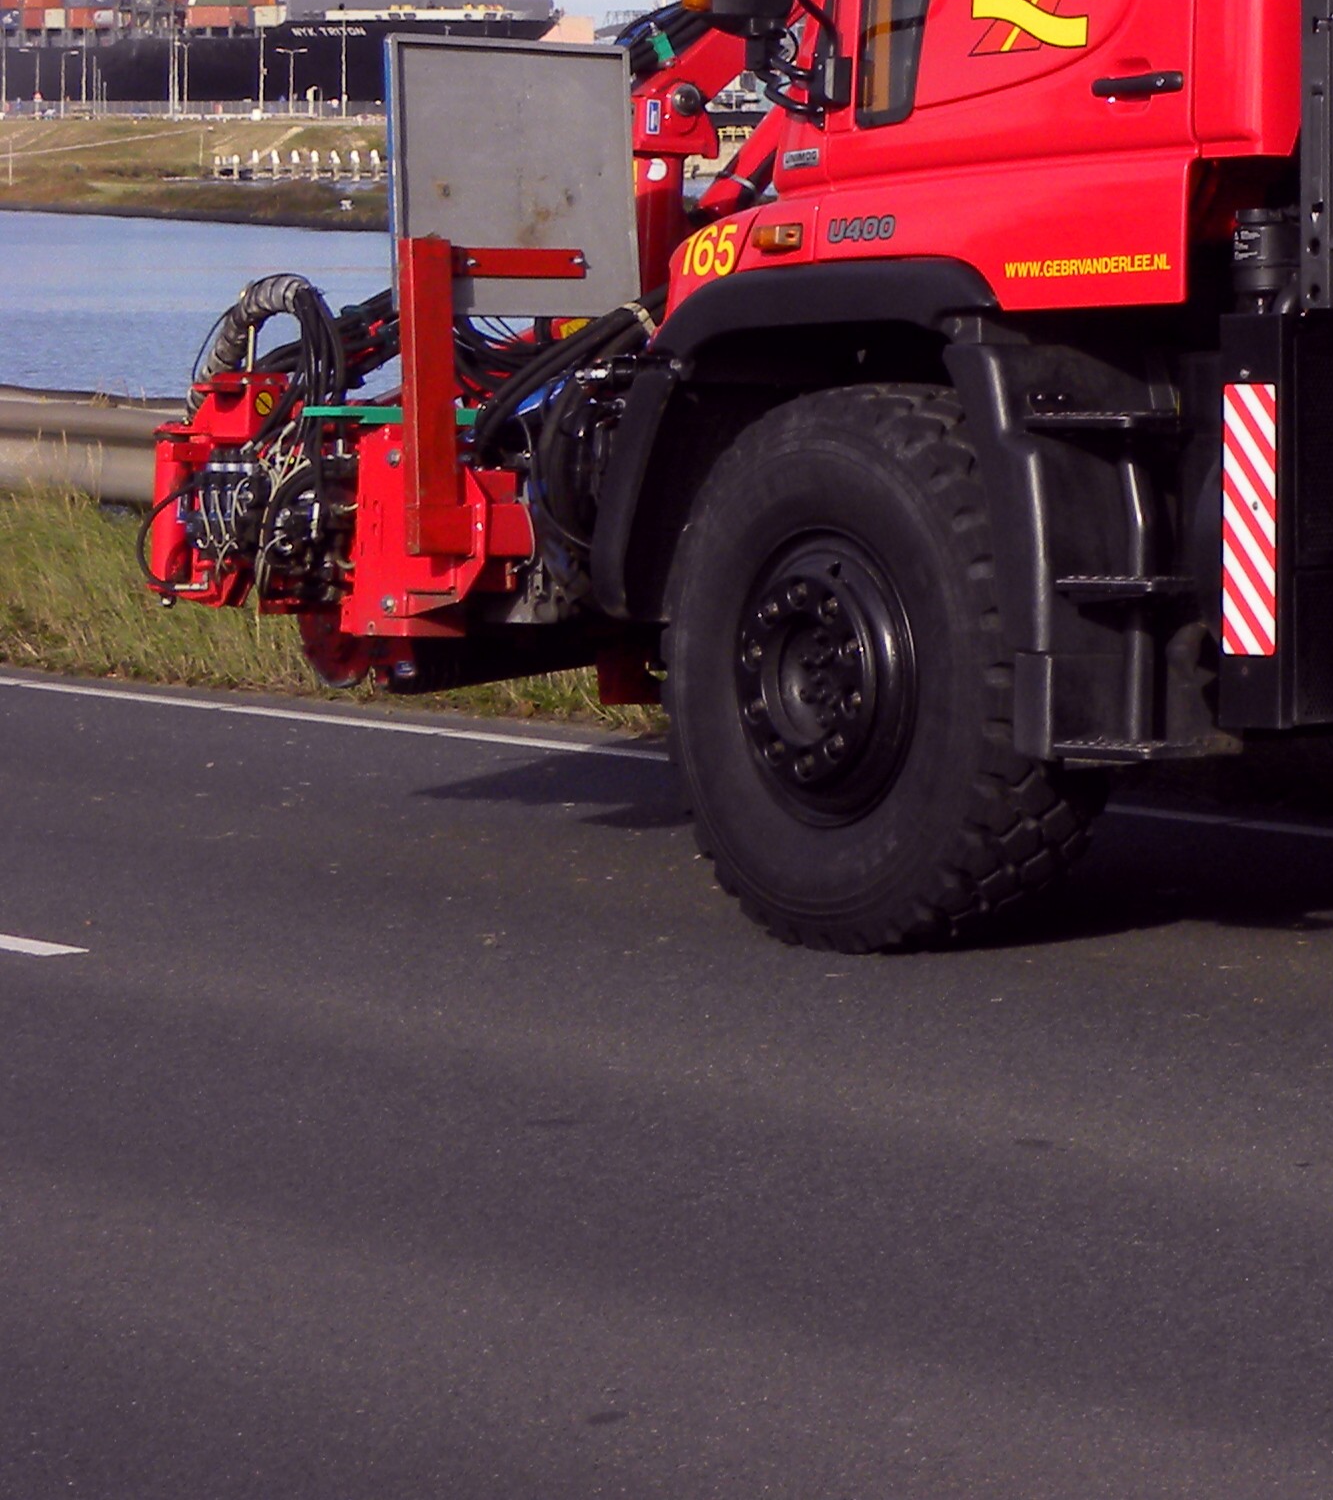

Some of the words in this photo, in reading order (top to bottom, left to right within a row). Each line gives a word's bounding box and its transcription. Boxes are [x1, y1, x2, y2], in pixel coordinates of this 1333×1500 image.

[291, 26, 317, 37] NYK
[318, 26, 367, 37] TRITON
[828, 214, 895, 244] U400
[682, 223, 738, 276] 165
[1005, 253, 1171, 278] WWW.GEBRVANDERLEE.NL
